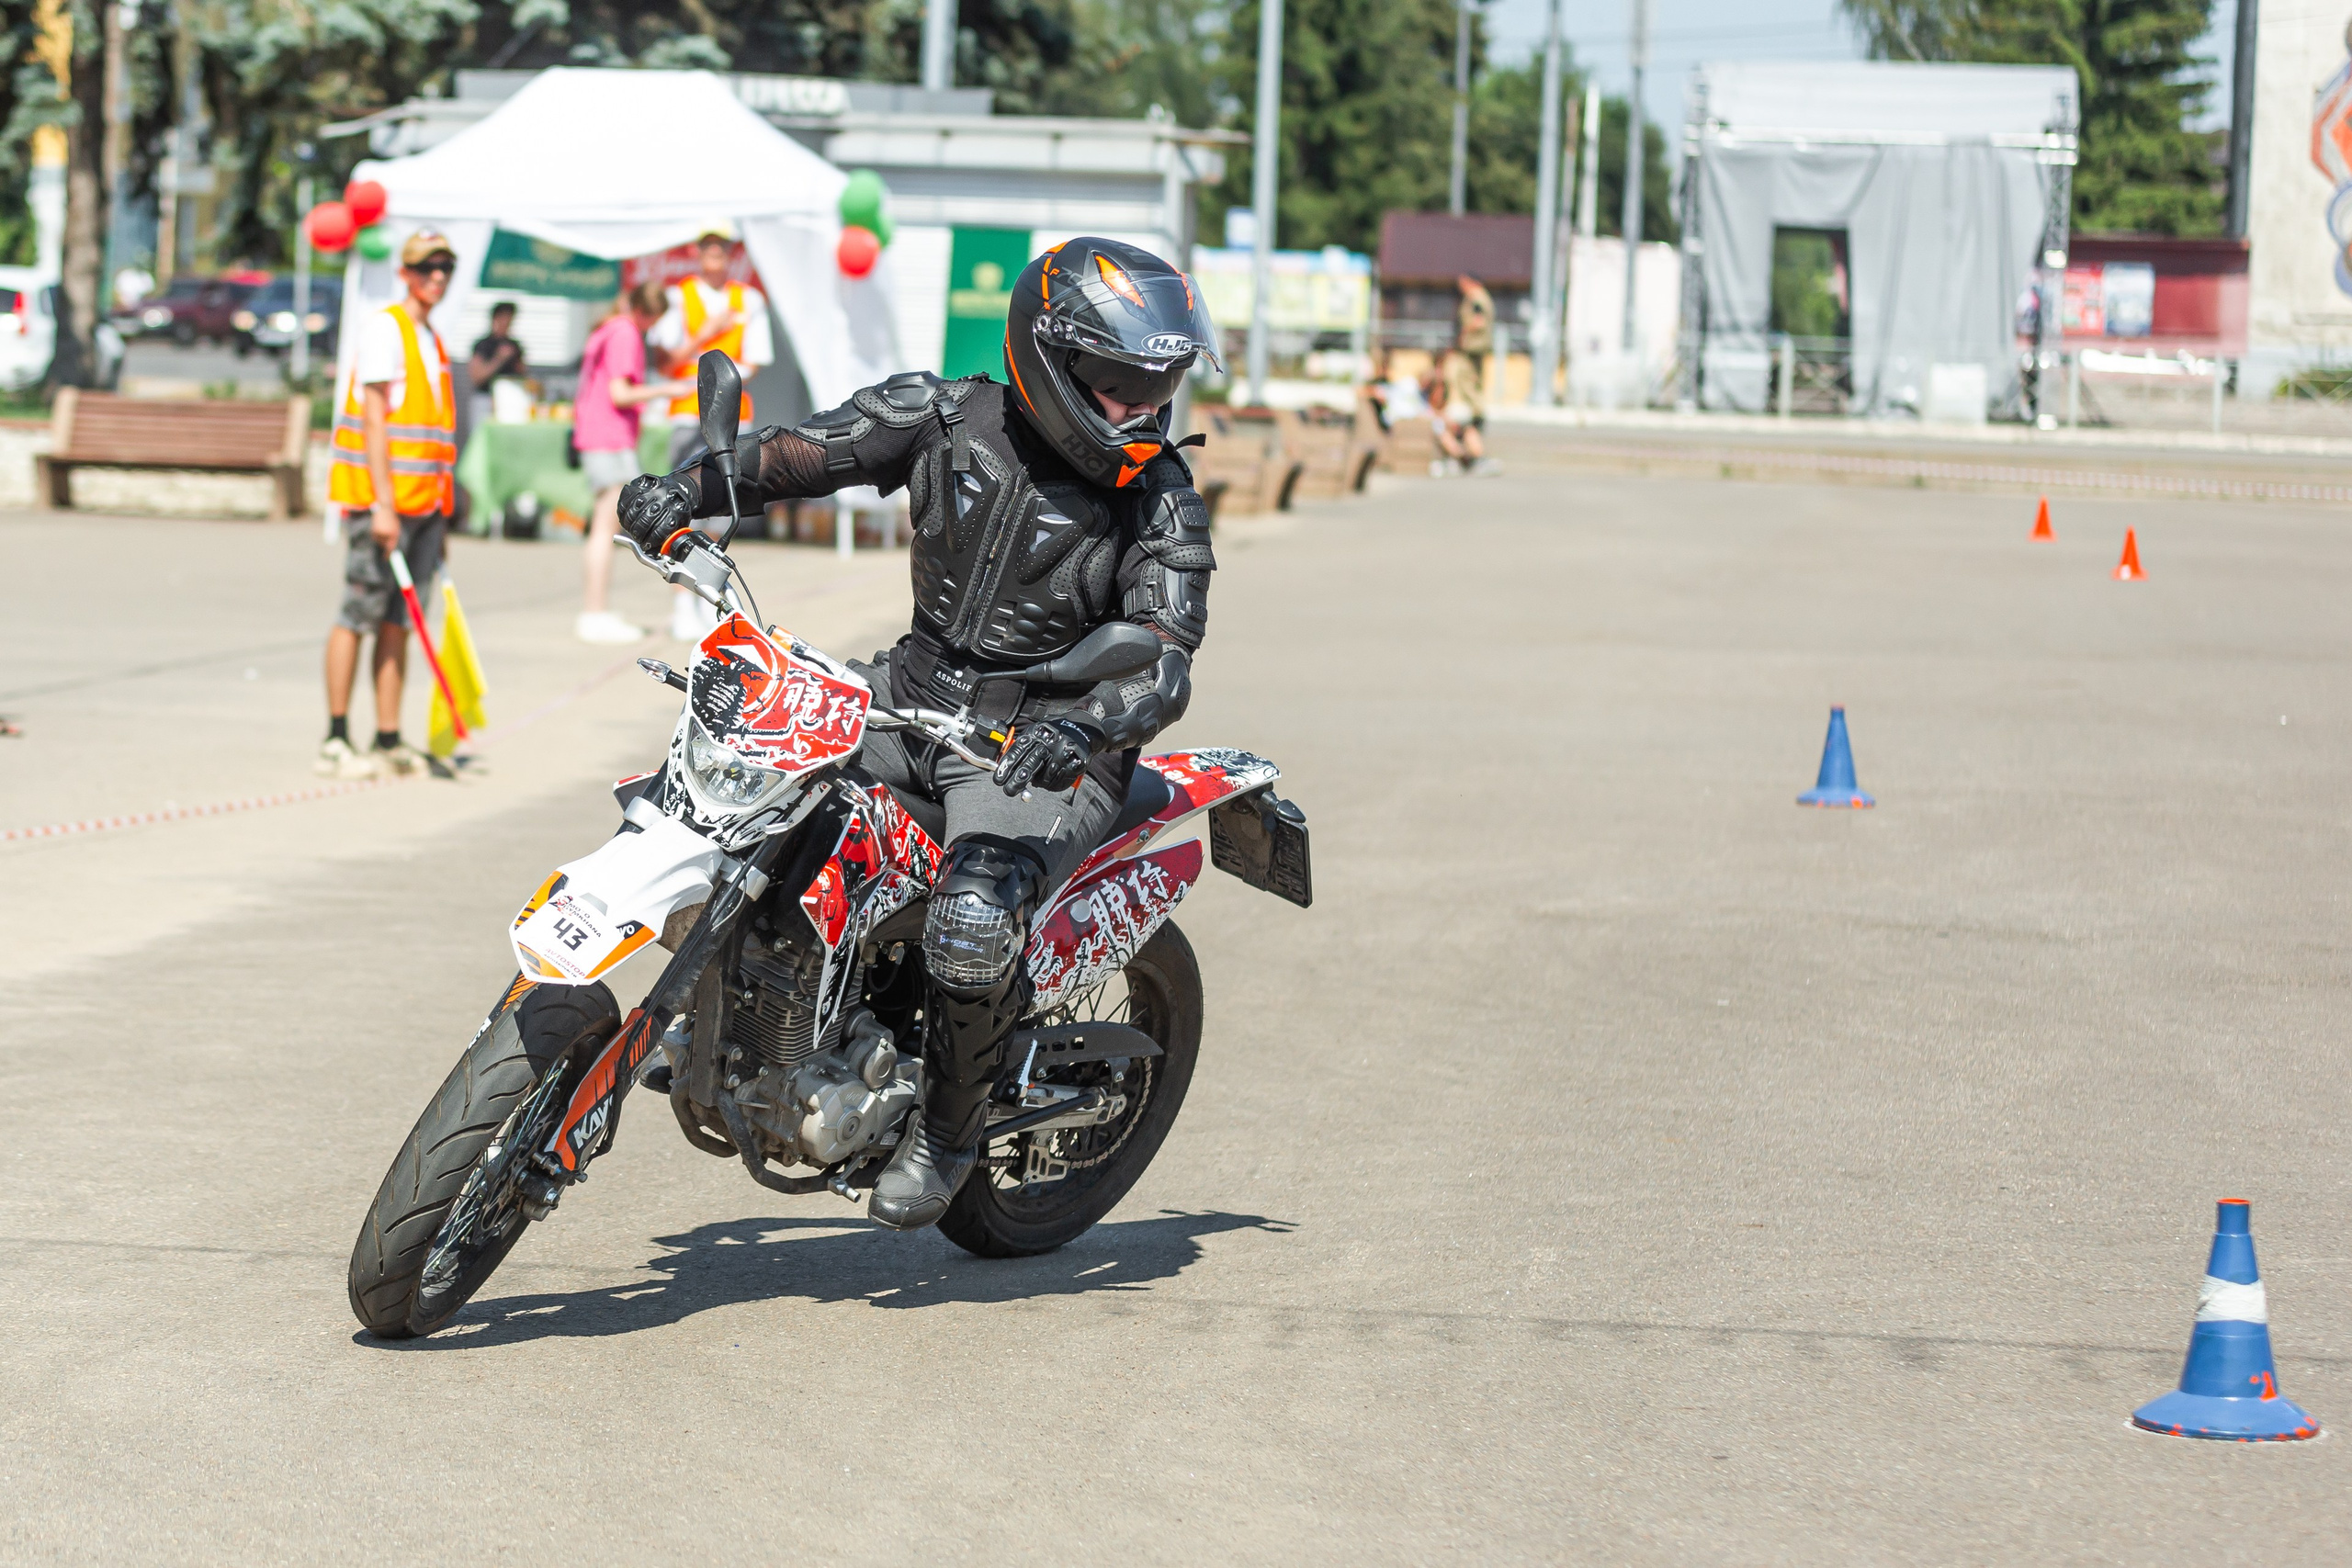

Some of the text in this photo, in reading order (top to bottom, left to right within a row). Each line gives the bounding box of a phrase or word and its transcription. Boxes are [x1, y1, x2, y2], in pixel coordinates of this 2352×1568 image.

[1150, 338, 1192, 353] HJC
[1061, 433, 1102, 473] HJC
[553, 917, 589, 951] 43
[546, 948, 586, 977] AVTOSTOP
[572, 1093, 614, 1149] KAY
